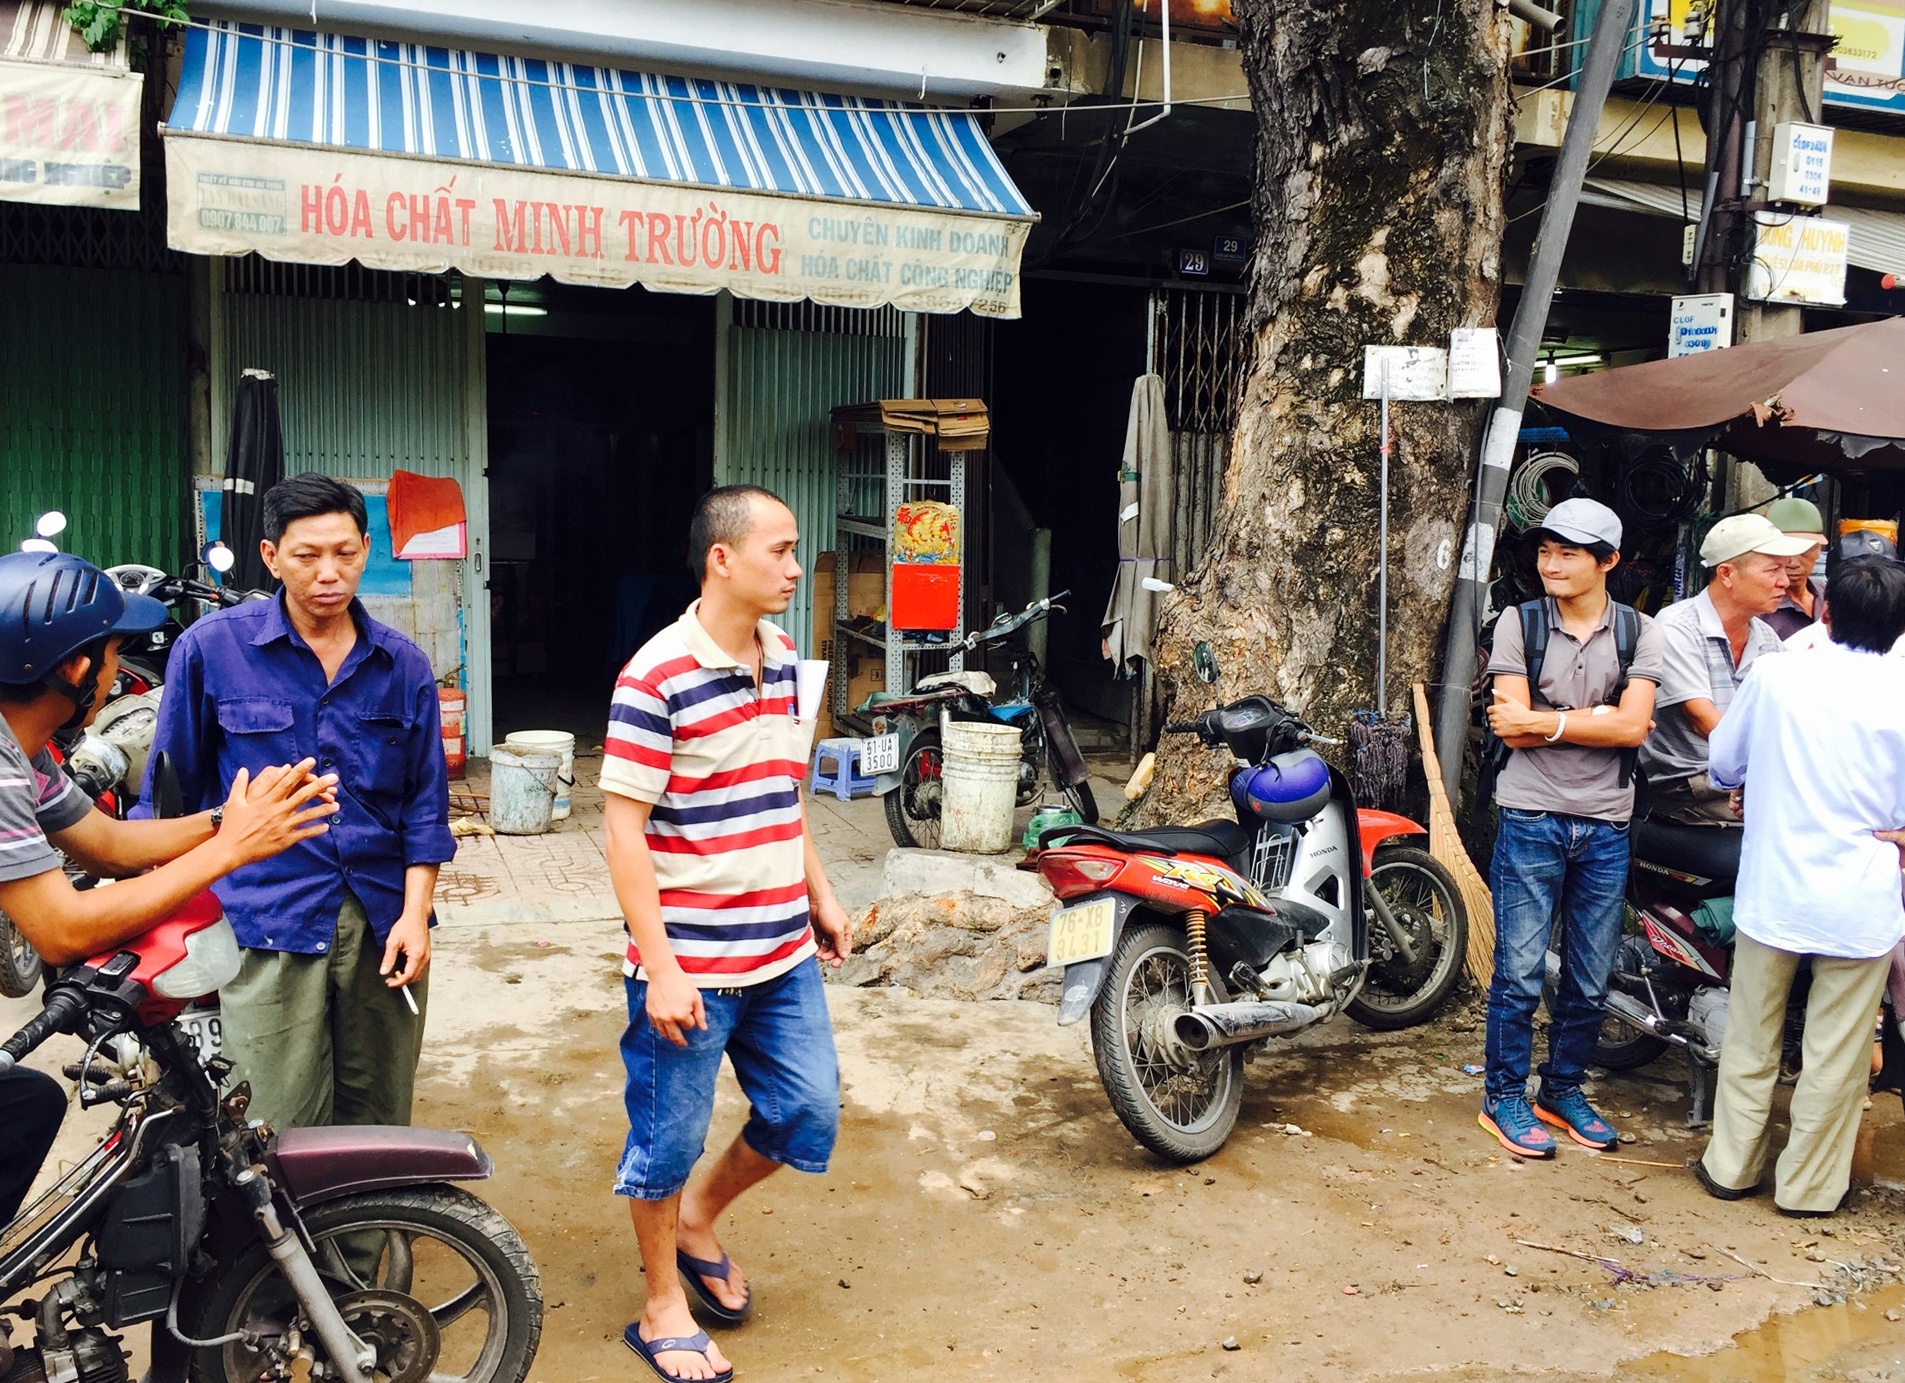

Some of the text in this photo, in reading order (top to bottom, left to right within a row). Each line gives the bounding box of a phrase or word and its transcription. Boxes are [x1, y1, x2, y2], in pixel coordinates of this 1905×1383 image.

[0, 158, 36, 184] NG
[301, 172, 782, 275] HÓA CHẤT MINH TRƯỜNG
[808, 216, 1009, 258] CHUYÊN KINH DOANH
[1223, 240, 1238, 252] 29
[800, 252, 1013, 297] HÓA CHẤT CÔNG NGHIỆP
[1185, 253, 1204, 271] 29
[826, 681, 834, 714] CHOPPED
[867, 753, 893, 771] 3500
[1309, 845, 1339, 858] HONDA
[1640, 861, 1670, 875] HONDA
[1059, 904, 1104, 935] 76-X8
